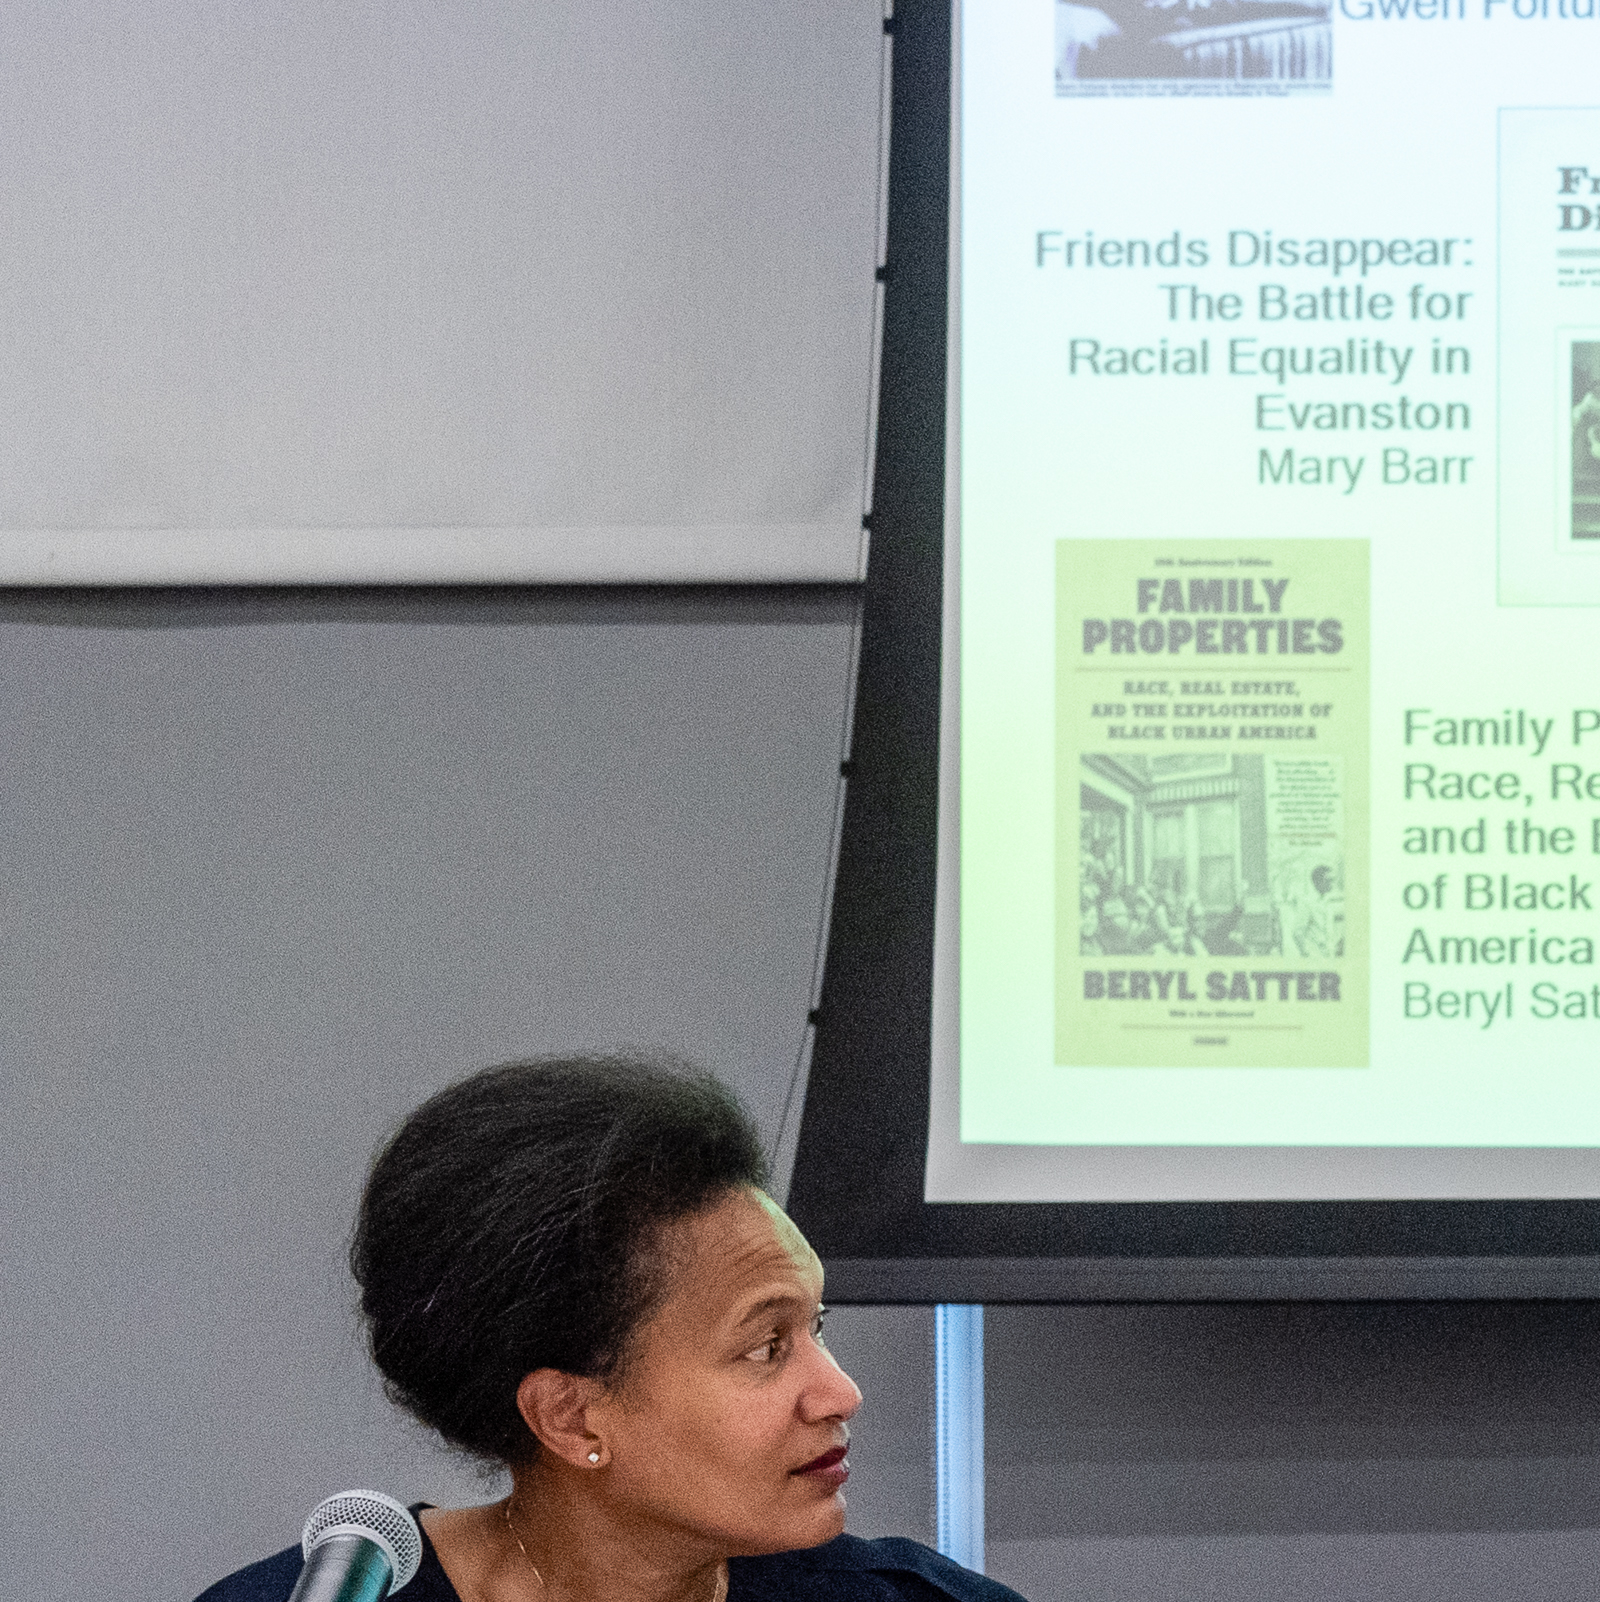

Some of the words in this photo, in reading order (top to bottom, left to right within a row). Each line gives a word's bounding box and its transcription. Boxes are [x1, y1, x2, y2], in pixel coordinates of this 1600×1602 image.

[1036, 230, 1210, 268] Friends
[1228, 230, 1472, 277] Disappear:
[1160, 284, 1243, 321] The
[1259, 283, 1395, 321] Battle
[1408, 283, 1472, 321] for
[1255, 393, 1471, 431] Evanston
[1138, 578, 1289, 614] FAMILY
[1083, 617, 1344, 655] PROPERTIES
[1108, 724, 1165, 739] BLACK
[1172, 724, 1231, 739] URBAN
[1238, 724, 1317, 740] AMERICA
[1404, 709, 1554, 757] Family
[1404, 763, 1533, 807] Race,
[1084, 970, 1197, 1001] BERYL
[1206, 971, 1342, 1003] SATTER
